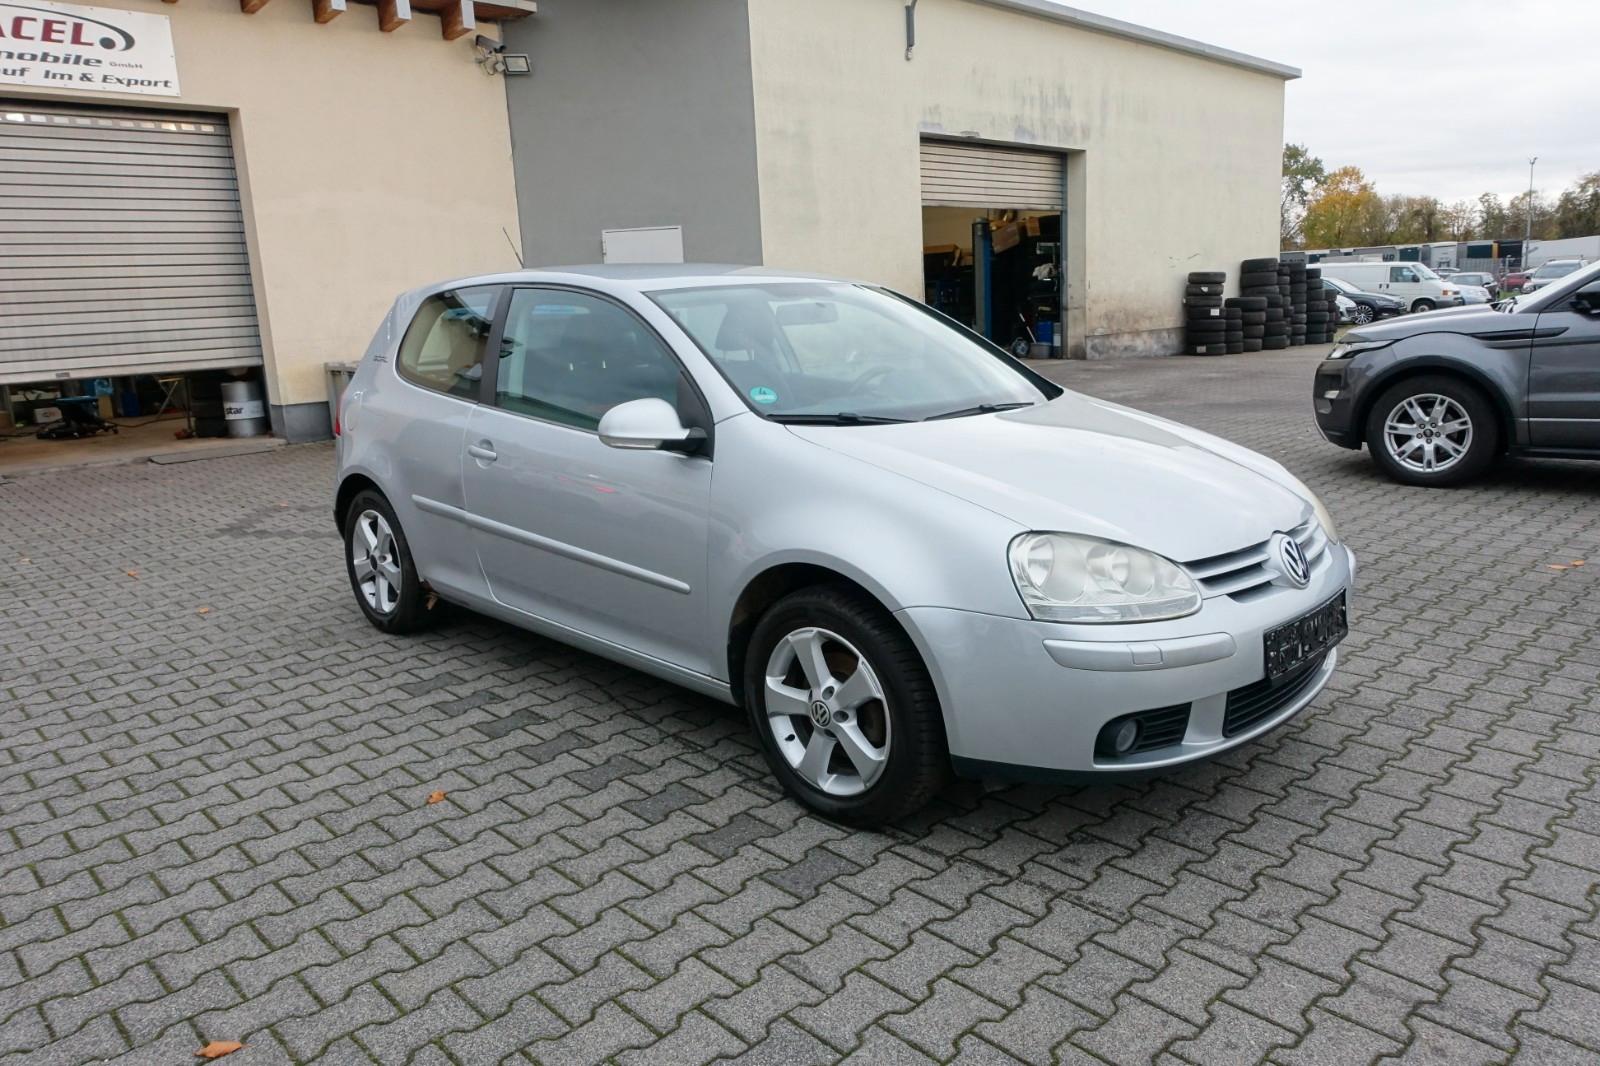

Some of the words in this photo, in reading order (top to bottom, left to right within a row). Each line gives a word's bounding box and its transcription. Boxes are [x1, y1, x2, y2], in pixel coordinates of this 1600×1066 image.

[0, 15, 95, 46] CEL
[79, 73, 95, 83] &
[102, 74, 172, 88] Export
